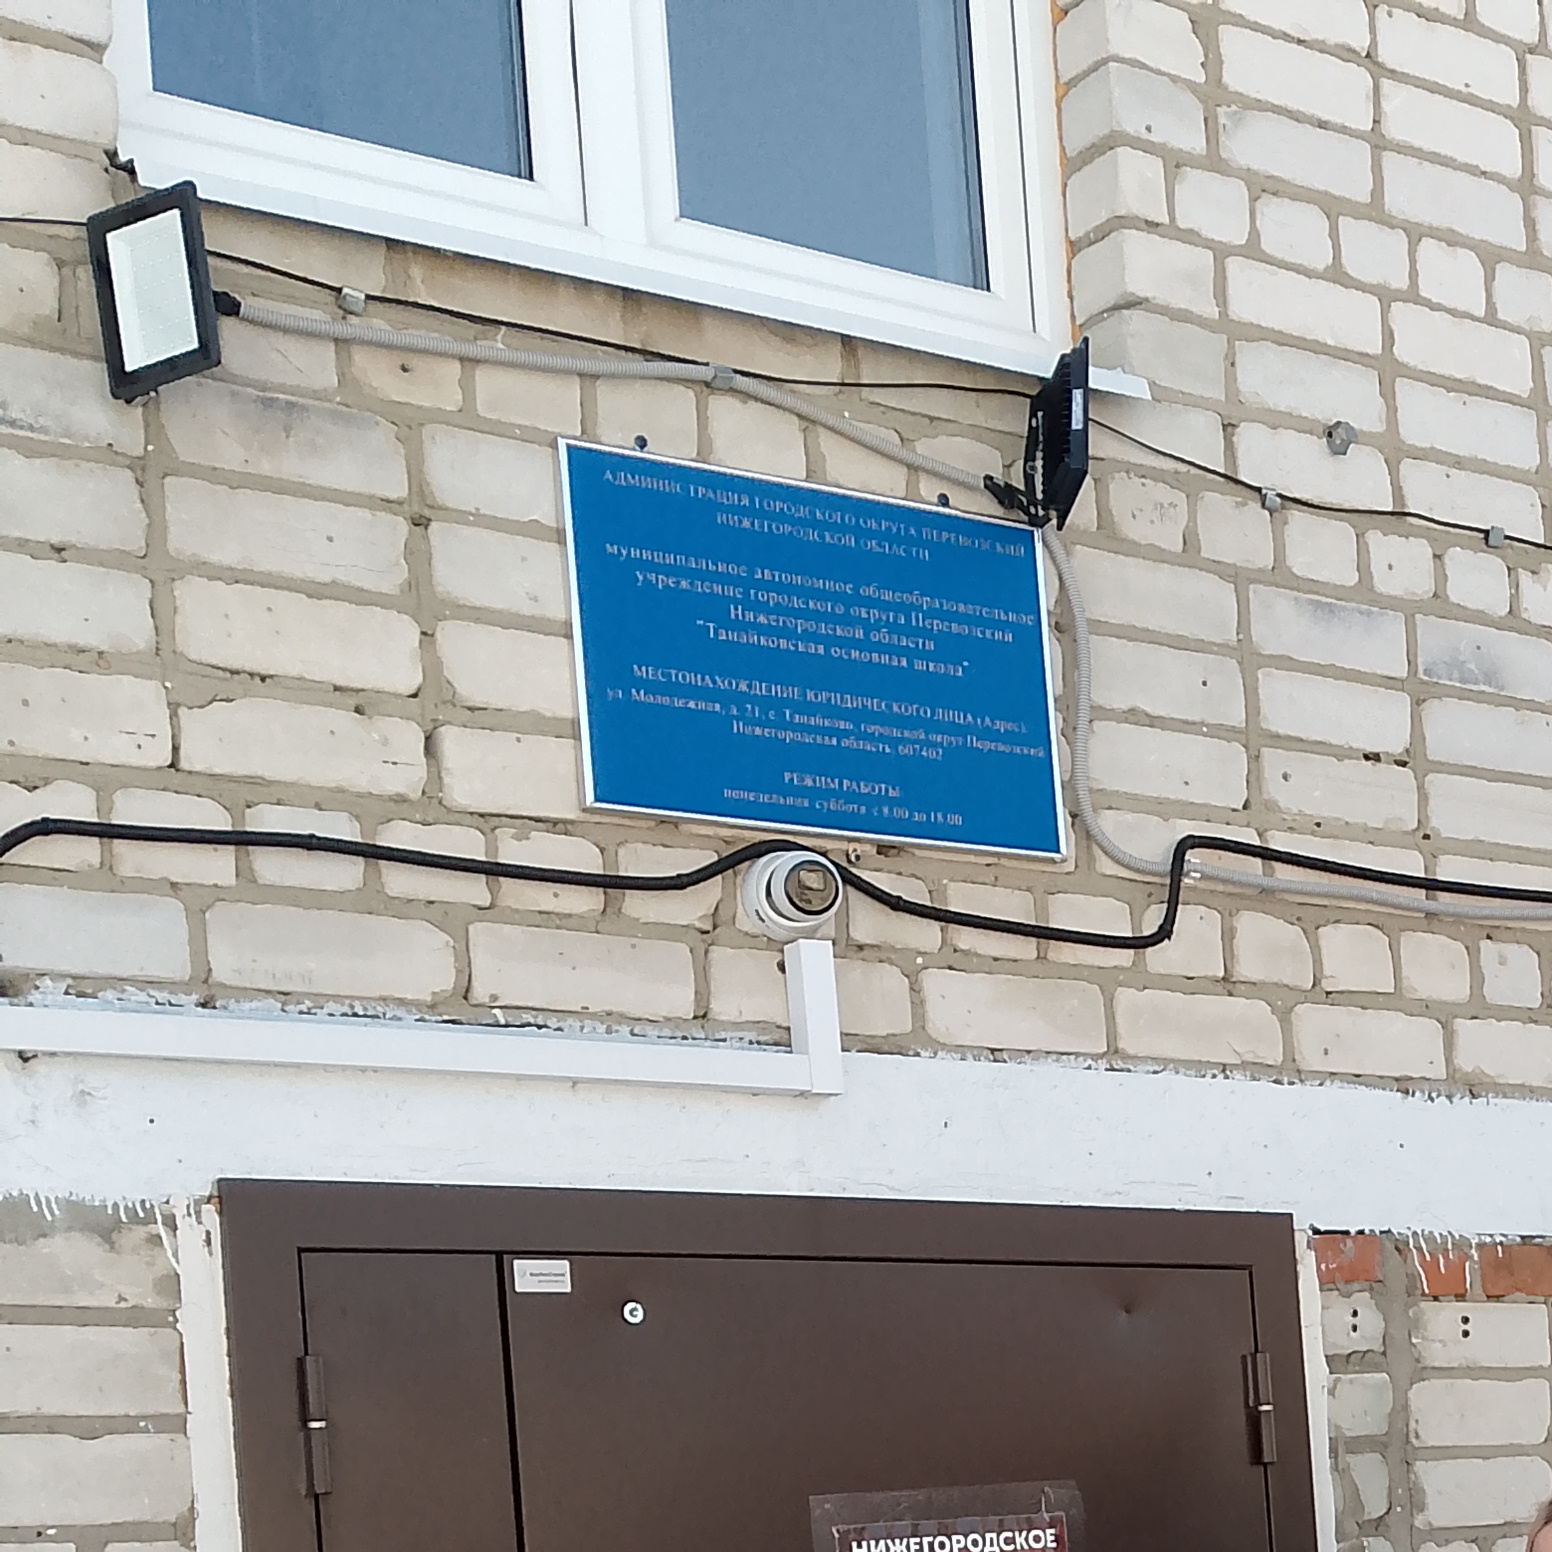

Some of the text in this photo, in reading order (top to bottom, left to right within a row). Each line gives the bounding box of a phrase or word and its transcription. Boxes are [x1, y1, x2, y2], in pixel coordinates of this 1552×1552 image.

[603, 468, 1025, 558] АДМИНИСТРАЦИЯ ГОРОДСКОГО ОКРУГА ПЕРЕВОЗСКИЙ
[717, 511, 930, 562] НИЖЕГОРОДСКОЙ ОБЛАСТИ
[605, 542, 1035, 626] муниципальное автономное общеобразовательное
[635, 569, 1013, 643] учреждение городского округа Перевозский
[730, 603, 935, 651] Нижегородской области
[831, 647, 908, 669] основная
[632, 664, 801, 701] МЕСТОНАХОЖДЕНИЕ
[805, 687, 931, 719] ЮРИДИЧЕСКОГО
[933, 706, 975, 725] ЛИЦА
[732, 719, 838, 746] Нижегородская
[783, 771, 839, 791] РЕЖИМ
